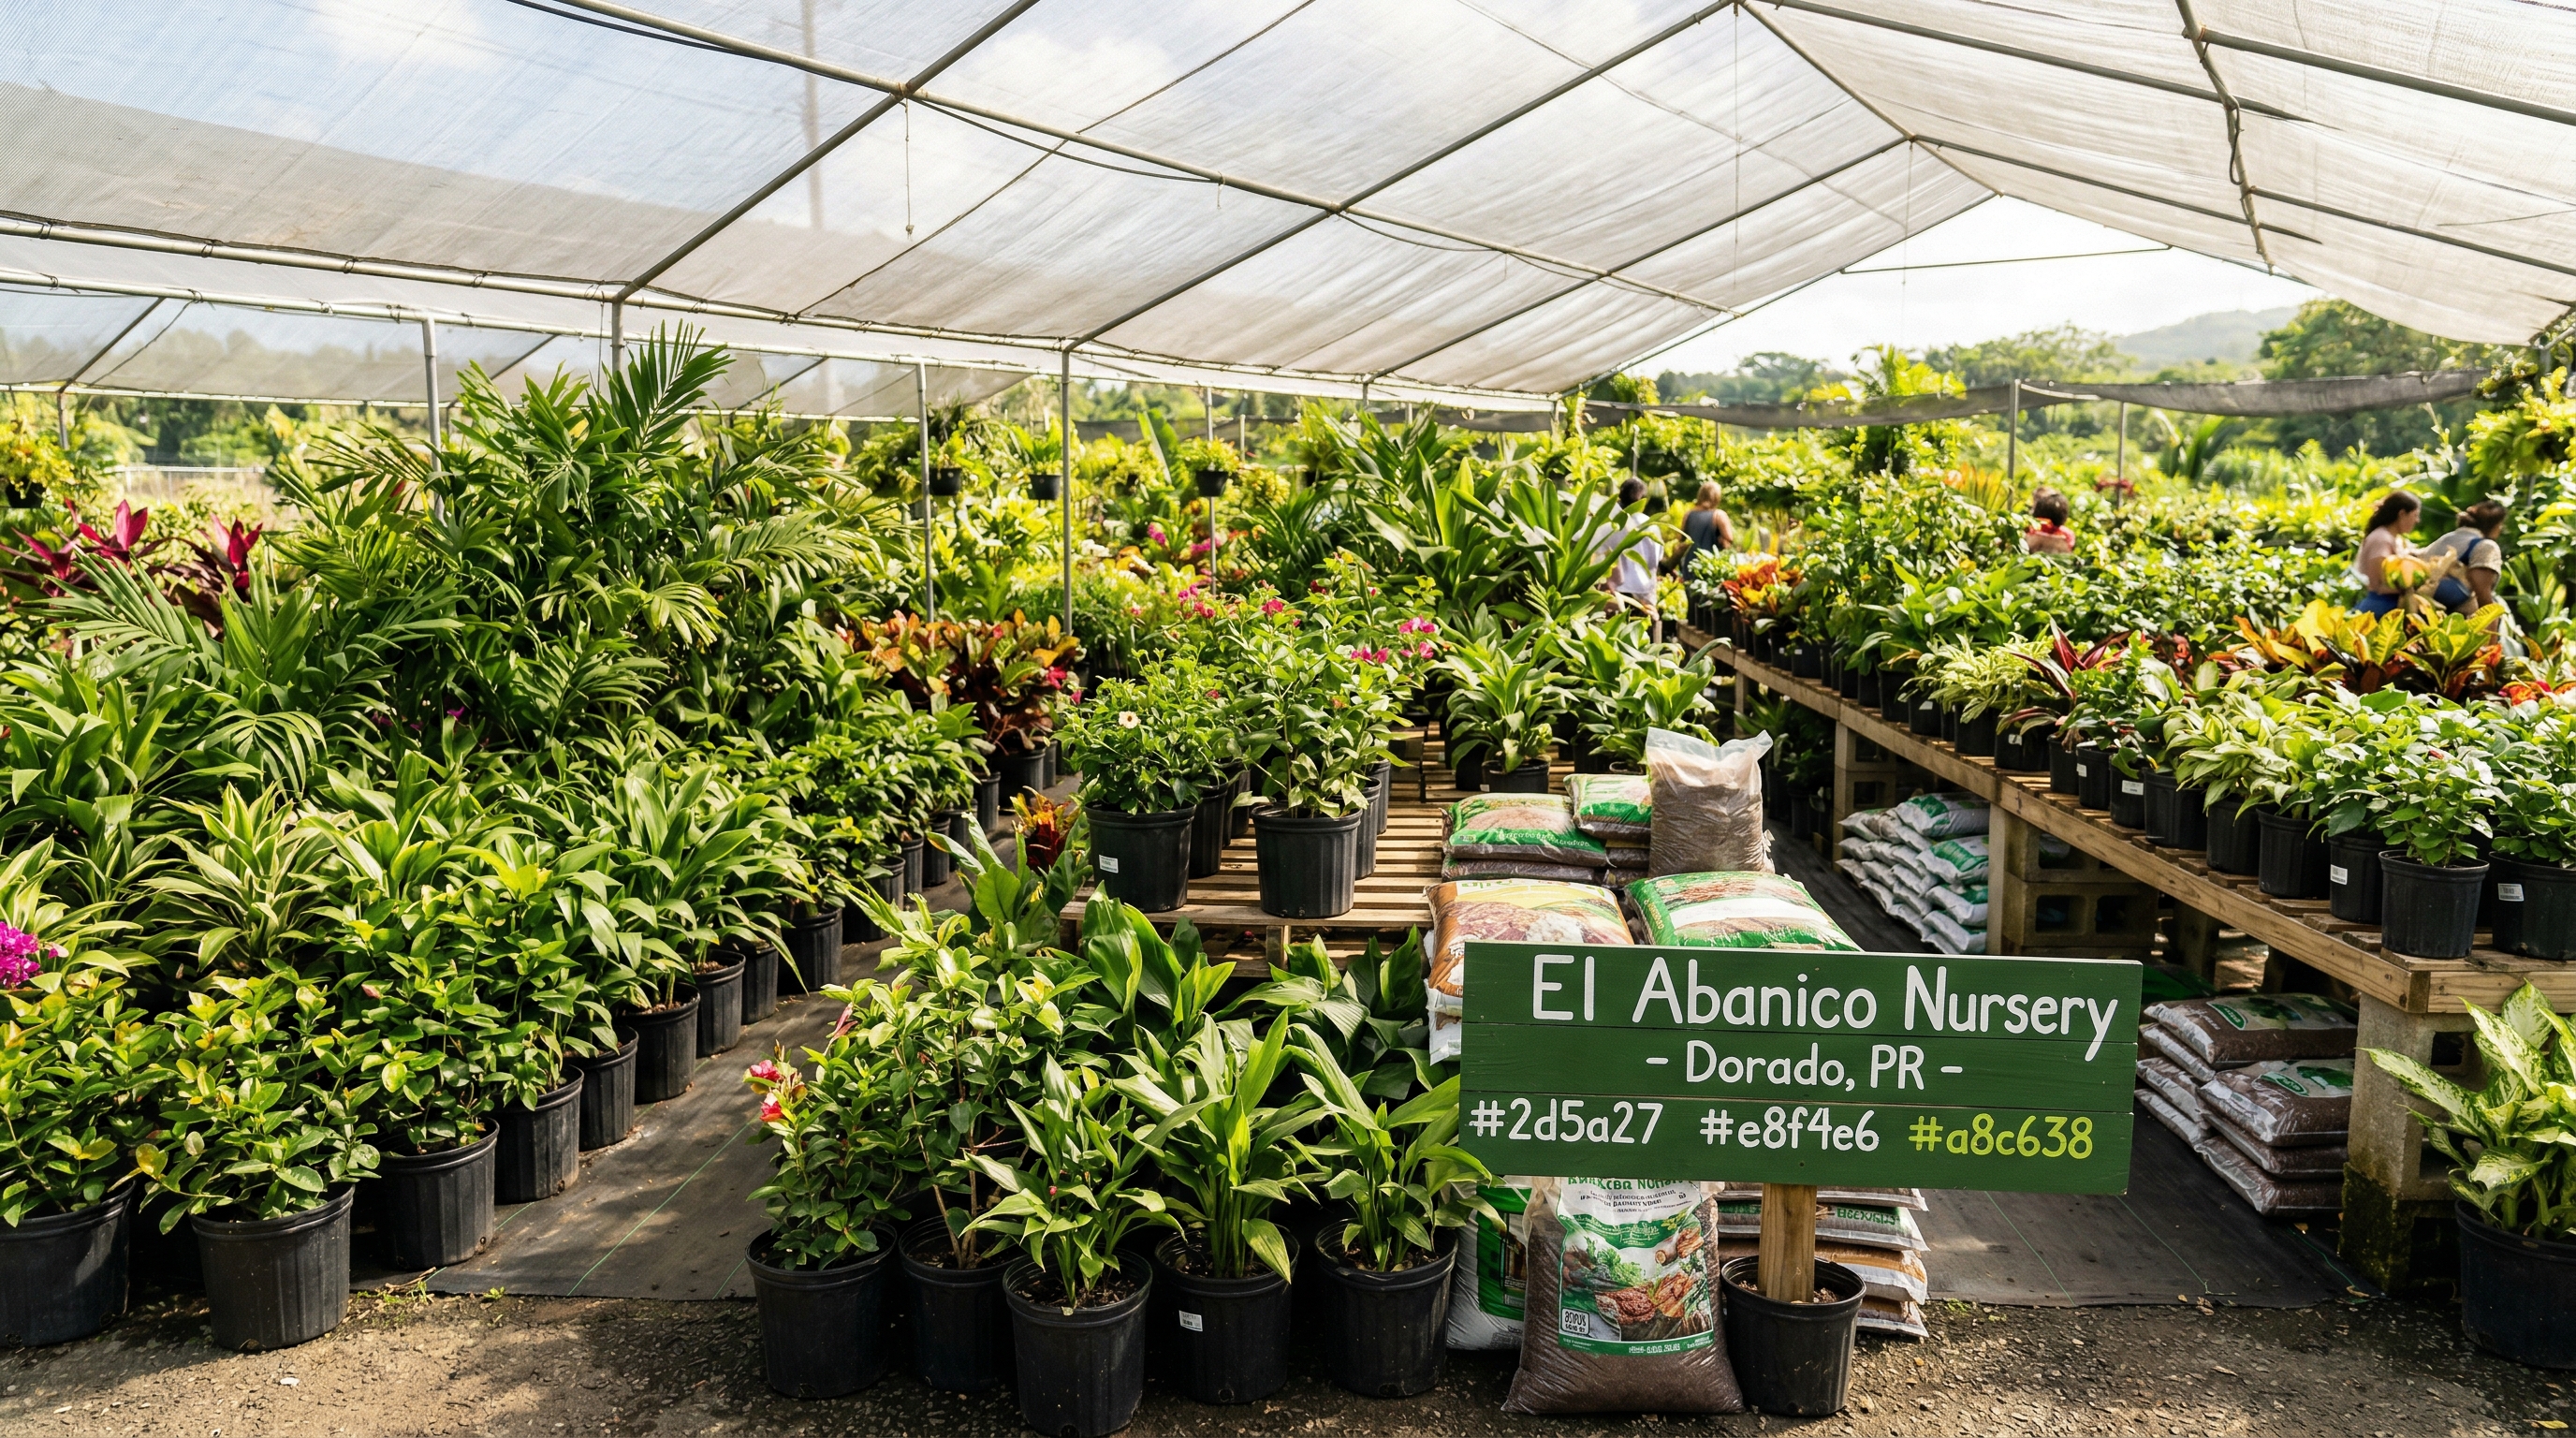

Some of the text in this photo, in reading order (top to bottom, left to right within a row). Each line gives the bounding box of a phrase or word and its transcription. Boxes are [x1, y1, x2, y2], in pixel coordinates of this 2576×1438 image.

[1532, 953, 2119, 1062] El Abanico Nursery
[1686, 1039, 1855, 1093] Dorado,
[1869, 1044, 1925, 1091] PR
[1469, 1097, 2094, 1160] #2d5a27 #e8f4e6 #a8c638
